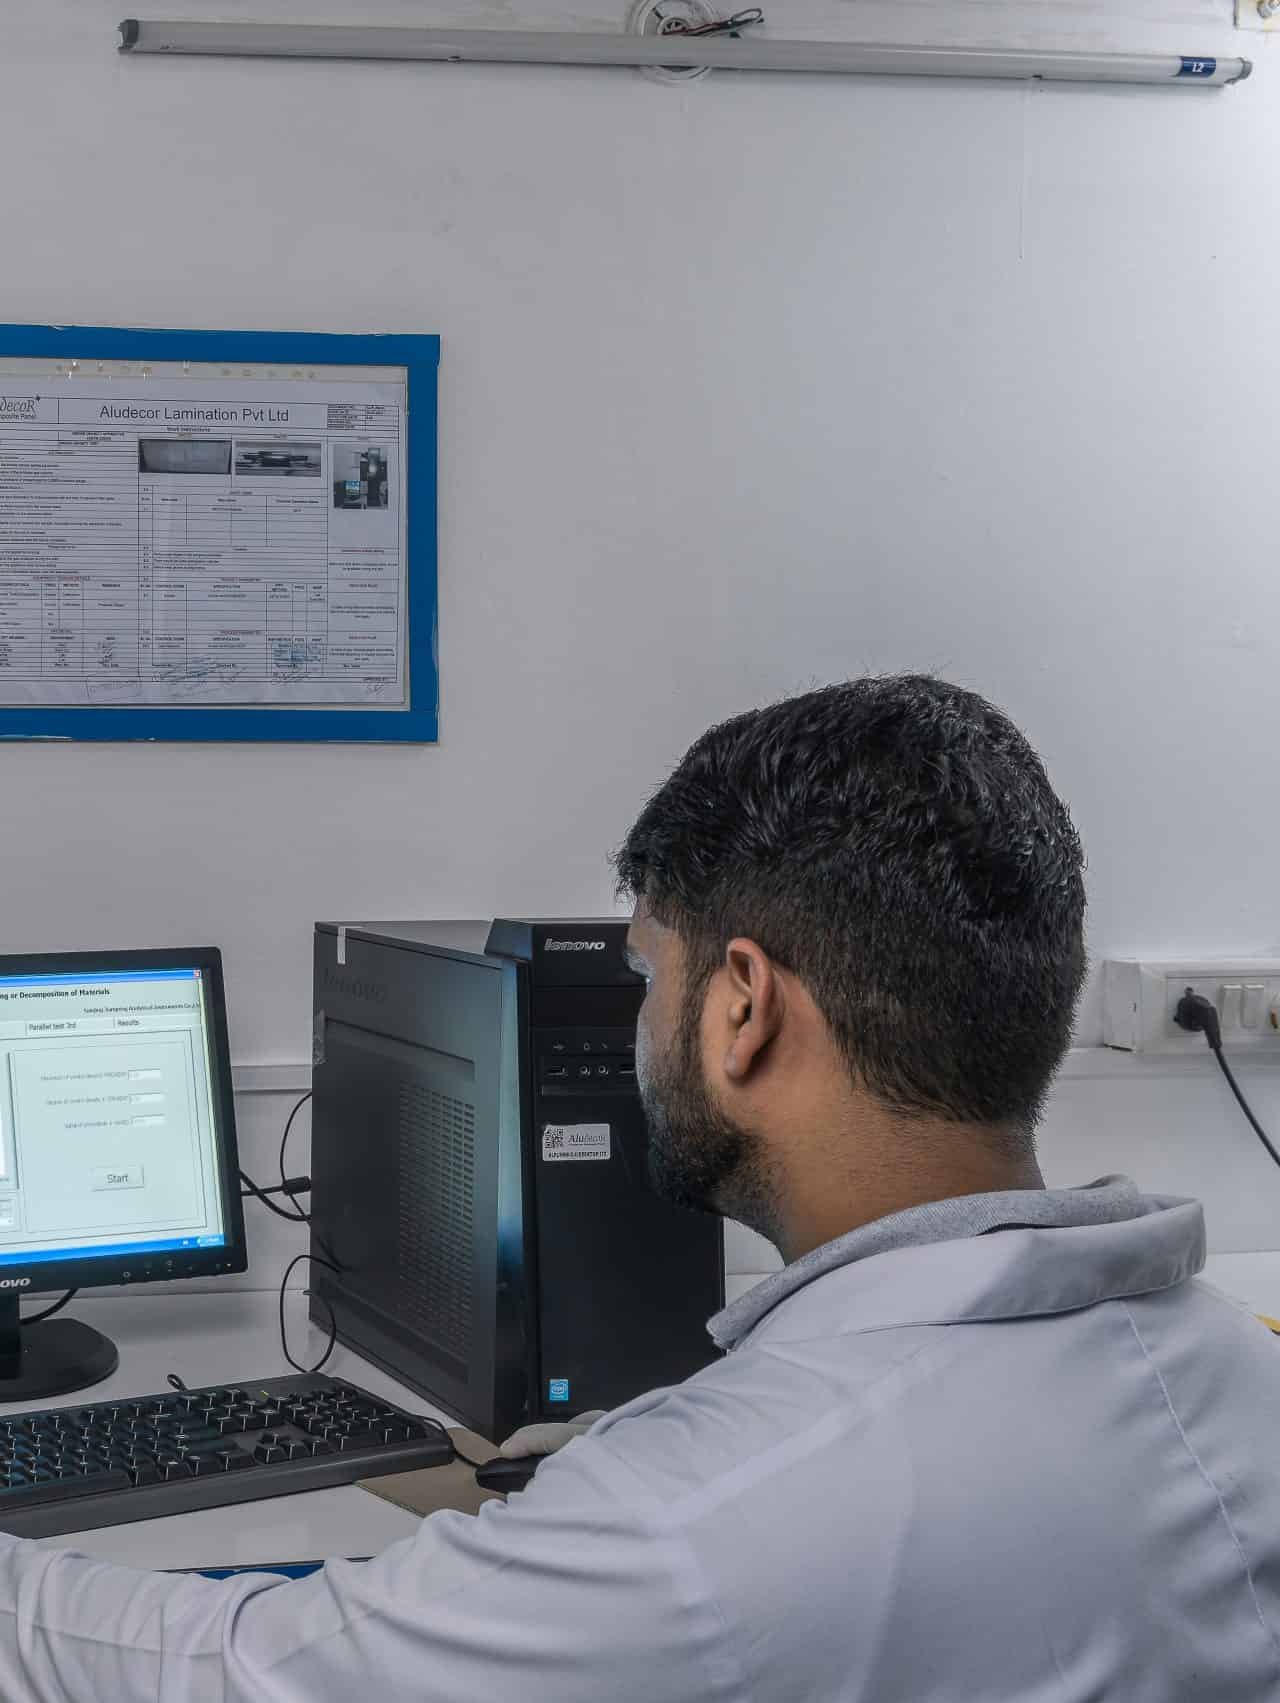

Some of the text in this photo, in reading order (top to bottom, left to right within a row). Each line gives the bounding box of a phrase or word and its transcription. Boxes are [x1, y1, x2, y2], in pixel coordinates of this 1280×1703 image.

[100, 406, 289, 421] Aludecor Lamination Pvt Ltd
[543, 938, 606, 951] lenovo
[20, 990, 68, 999] Decomposition
[80, 988, 110, 996] Materials
[29, 1023, 52, 1031] Parallel
[107, 1174, 129, 1184] Start
